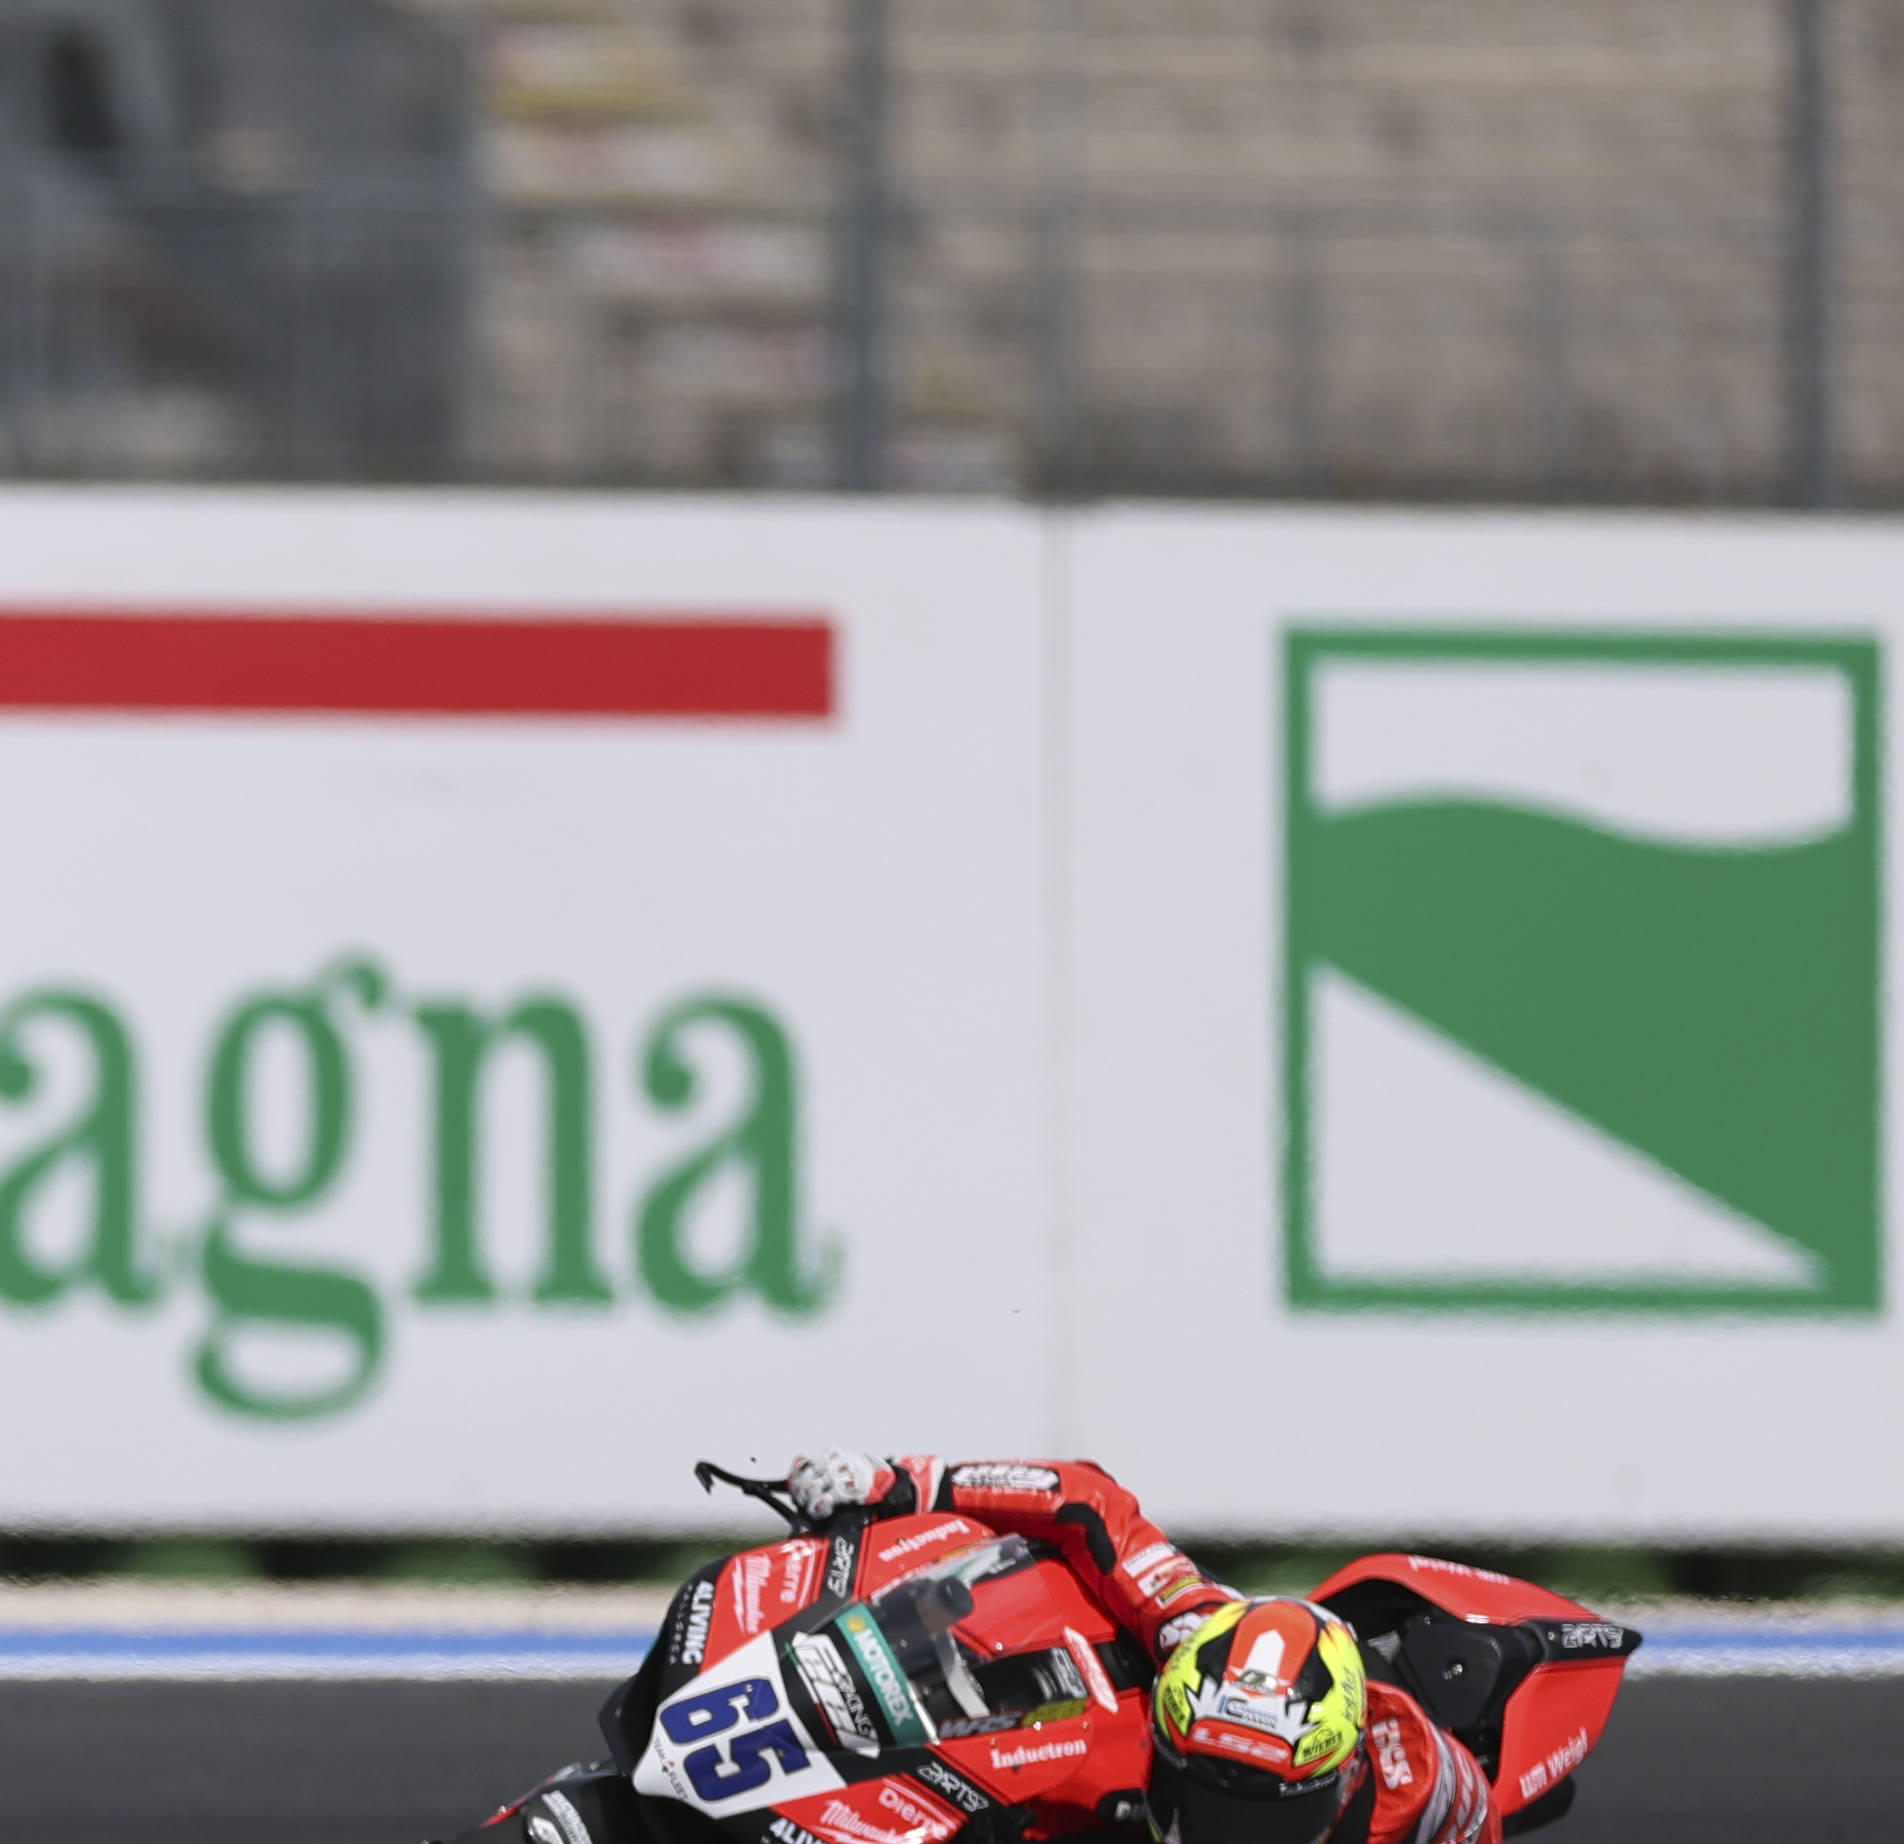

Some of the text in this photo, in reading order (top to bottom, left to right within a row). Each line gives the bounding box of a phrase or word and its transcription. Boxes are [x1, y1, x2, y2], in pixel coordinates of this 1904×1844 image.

[854, 1629, 914, 1726] MOTOREX
[653, 1738, 688, 1801] TEAM FLEET
[660, 1678, 811, 1802] 65
[990, 1738, 1088, 1770] Inductron
[1193, 1727, 1290, 1763] LS2
